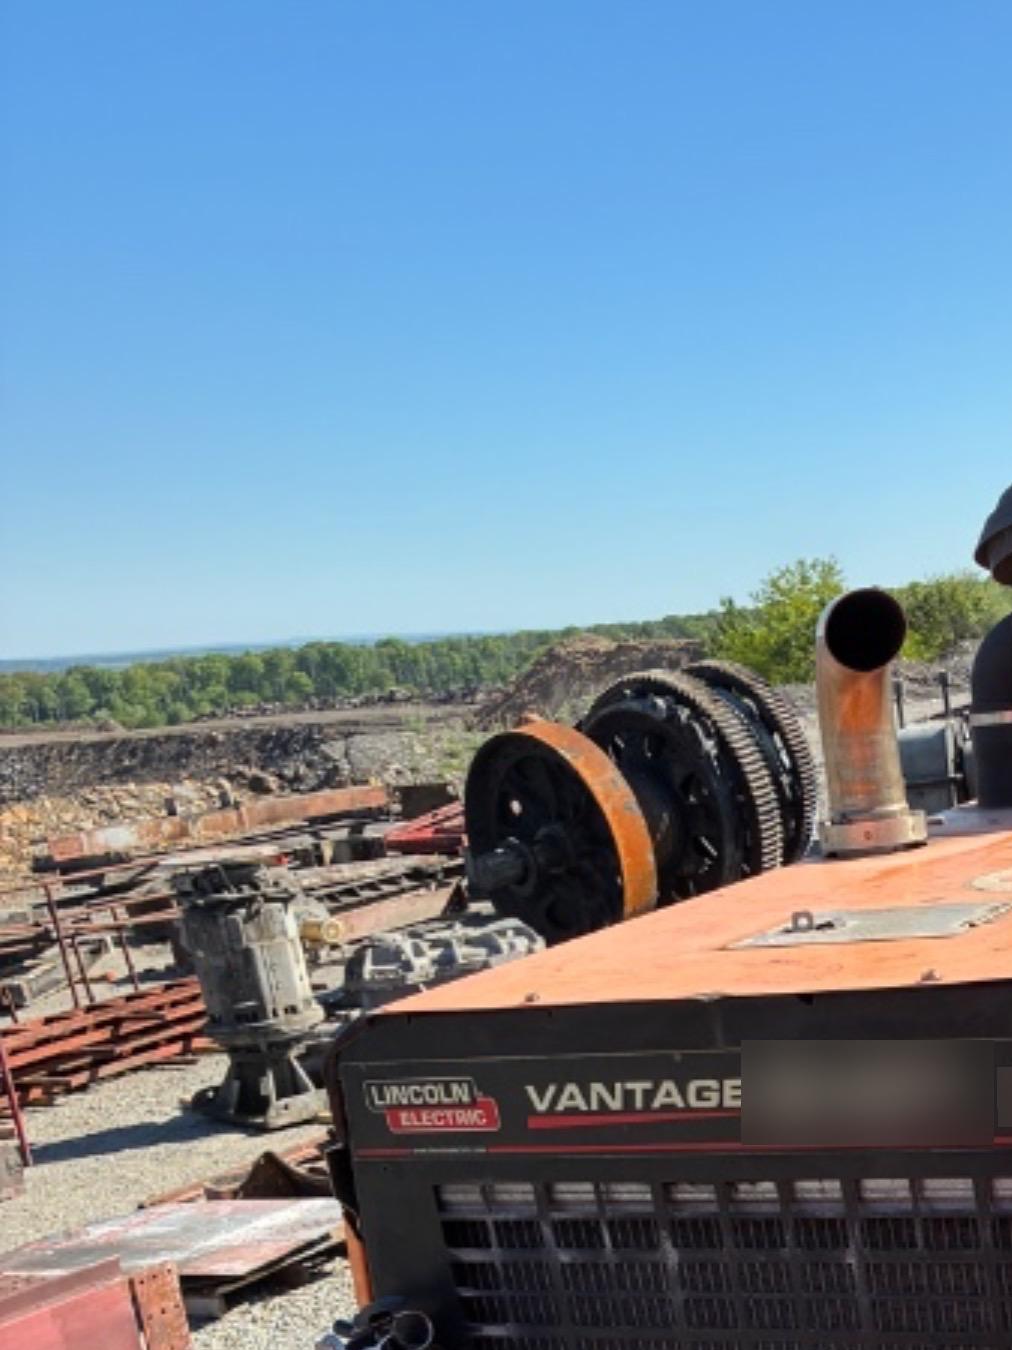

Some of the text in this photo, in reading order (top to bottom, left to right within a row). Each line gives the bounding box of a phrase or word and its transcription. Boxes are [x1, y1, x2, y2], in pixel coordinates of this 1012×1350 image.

[370, 1081, 472, 1106] LINCOLN
[525, 1078, 742, 1112] VANTAGE
[399, 1107, 488, 1127] ELECTRIC
